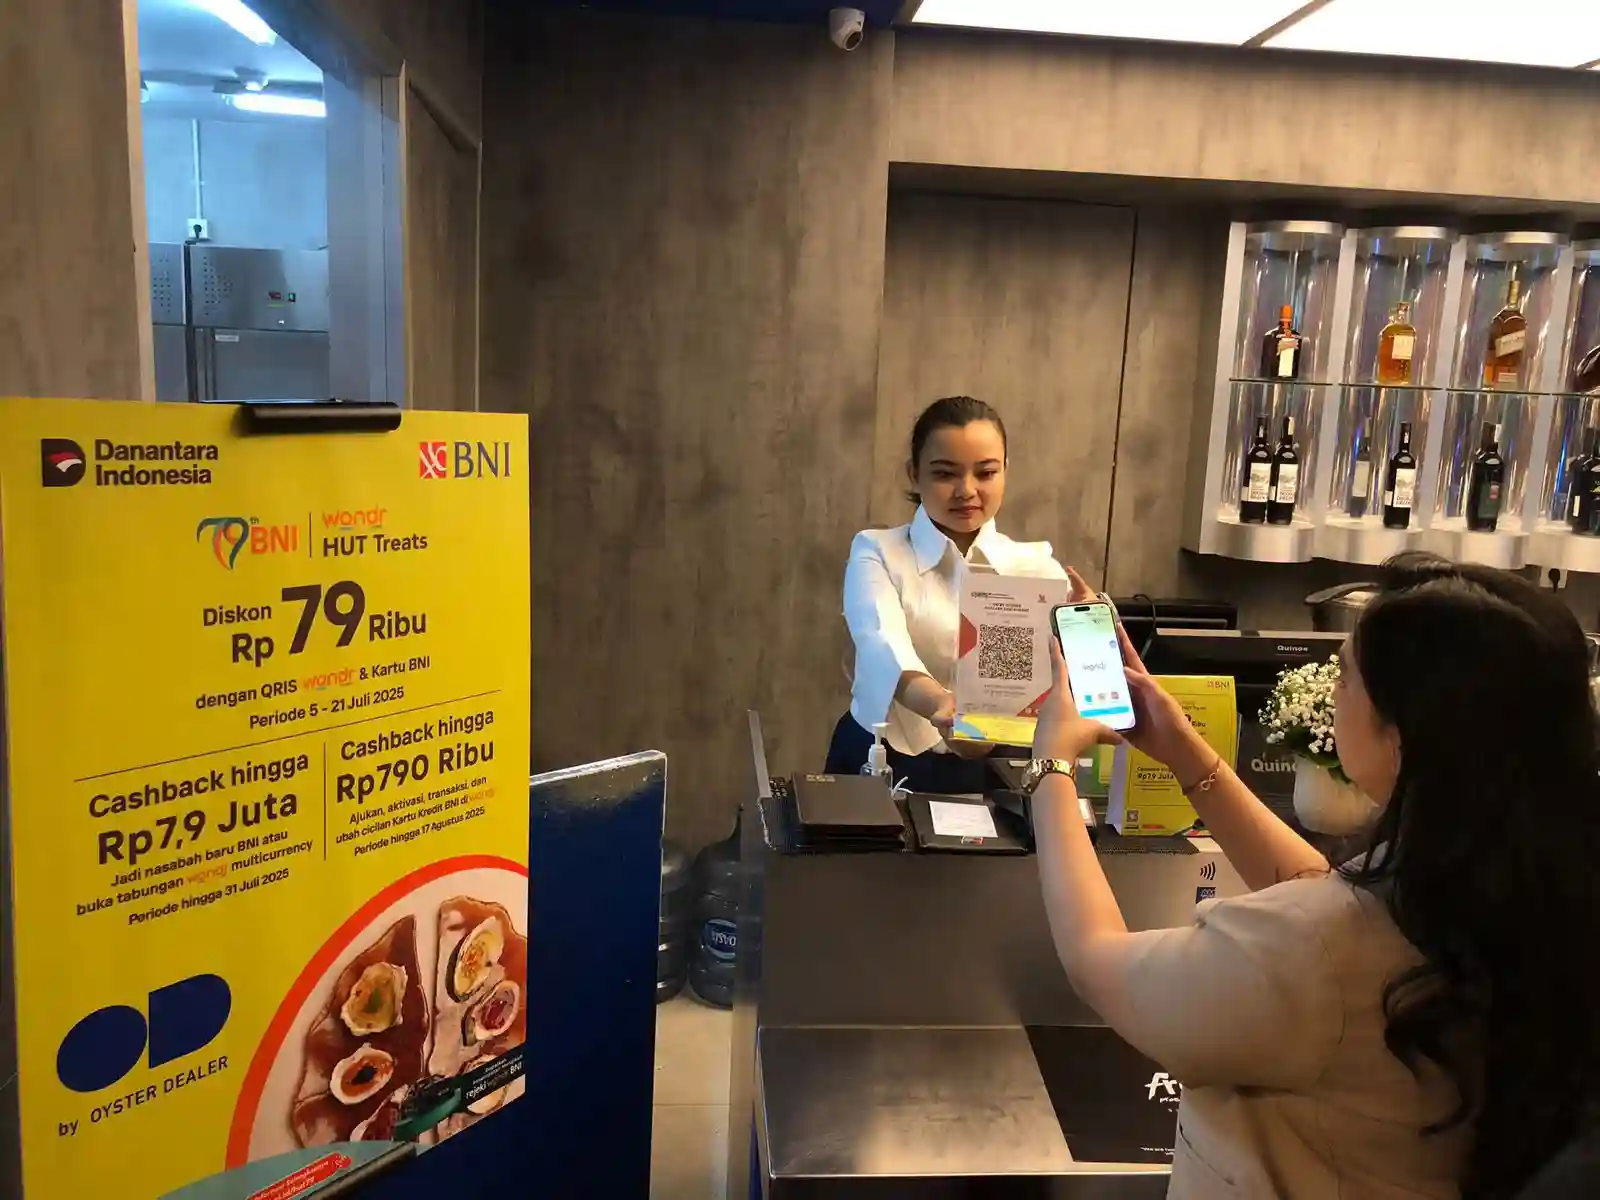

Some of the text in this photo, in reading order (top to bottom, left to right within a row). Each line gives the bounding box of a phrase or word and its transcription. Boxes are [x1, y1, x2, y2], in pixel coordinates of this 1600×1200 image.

[94, 438, 219, 462] Danantara
[453, 441, 512, 480] BNI
[94, 464, 212, 487] Indonesia
[249, 524, 299, 555] BNI
[322, 505, 388, 530] wondr
[322, 532, 429, 558] HUT Treats
[202, 604, 273, 627] Diskon
[231, 580, 427, 669] Rp 79 Ribu
[195, 655, 431, 710] dengan QRIS wondr & Kartu BNI
[1214, 680, 1231, 690] BNI
[249, 706, 306, 730] Periode
[308, 703, 319, 718] 5
[330, 700, 346, 713] 21
[347, 694, 371, 710] Juli
[373, 686, 405, 704] 2025
[340, 710, 495, 761] Cashback hingga
[89, 753, 309, 818] Cashback hingga
[336, 740, 495, 805] Rp790 Ribu
[470, 775, 487, 789] dan
[1251, 757, 1299, 773] Quino
[97, 792, 298, 866] Rp7,9 Juta
[335, 828, 360, 845] ubah
[361, 818, 392, 837] cicilan
[392, 812, 417, 827] Kartu
[417, 802, 443, 819] Kredit
[444, 798, 460, 811] BNI
[460, 794, 469, 806] di
[353, 806, 486, 857] Periode hingga 17 Agustus 2025
[76, 896, 114, 916] buka
[116, 877, 185, 906] tabungan
[230, 838, 314, 872] multicurrency
[110, 830, 288, 888] Jadi nasabah baru BNI atau
[128, 867, 290, 926] Periode hingga 31 Juli 2025
[57, 1054, 229, 1139] by OYSTER DEALER
[465, 1080, 487, 1100] rejeki
[509, 1062, 523, 1076] BNI
